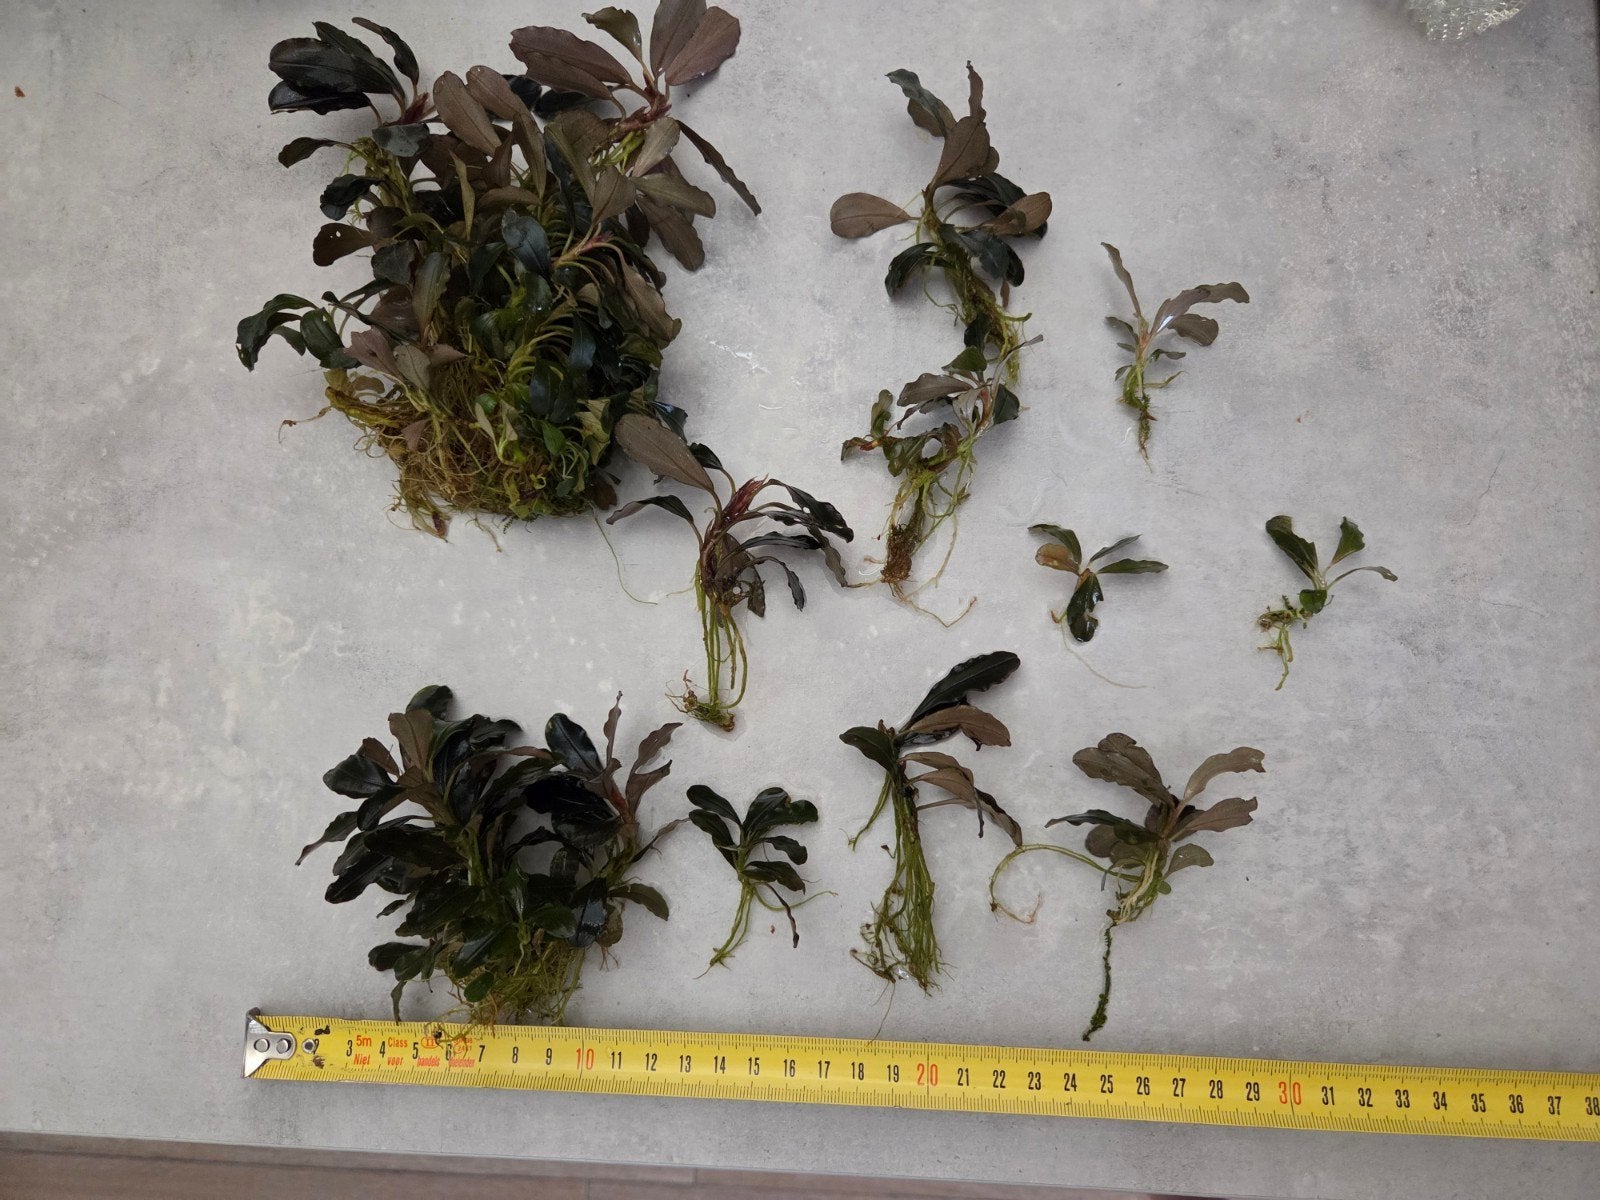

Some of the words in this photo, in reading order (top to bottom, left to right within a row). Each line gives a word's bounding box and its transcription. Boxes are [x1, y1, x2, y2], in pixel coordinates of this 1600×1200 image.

[356, 1035, 372, 1047] 5m
[387, 1036, 408, 1048] Class
[353, 1053, 371, 1066] Niet
[387, 1056, 403, 1067] voor
[346, 1040, 353, 1057] 3
[379, 1041, 386, 1058] 4
[412, 1042, 419, 1059] 5
[445, 1044, 452, 1061] 6
[478, 1045, 486, 1062] 7
[511, 1047, 519, 1064] 8
[545, 1048, 553, 1065] 9
[576, 1048, 595, 1070] 10
[611, 1051, 622, 1069] 11
[646, 1053, 658, 1071] 12
[680, 1055, 692, 1073] 13
[714, 1055, 726, 1074] 14
[748, 1057, 760, 1075] 15
[784, 1059, 796, 1077] 16
[818, 1060, 831, 1079] 17
[851, 1061, 865, 1080] 18
[887, 1064, 900, 1083] 19
[917, 1063, 938, 1086] 20
[957, 1068, 970, 1086] 21
[992, 1070, 1006, 1088] 22
[1028, 1071, 1042, 1090] 23
[1064, 1073, 1077, 1092] 24
[1100, 1074, 1114, 1094] 25
[1136, 1076, 1150, 1096] 26
[1172, 1078, 1186, 1097] 27
[1209, 1079, 1224, 1099] 28
[1246, 1082, 1260, 1101] 29
[1279, 1081, 1302, 1105] 30
[1322, 1086, 1335, 1106] 31
[1358, 1088, 1373, 1107] 32
[1395, 1089, 1410, 1108] 33
[1433, 1091, 1447, 1111] 34
[1471, 1093, 1486, 1112] 35
[1509, 1094, 1524, 1114] 36
[1548, 1096, 1562, 1115] 37
[1585, 1096, 1600, 1116] 38
